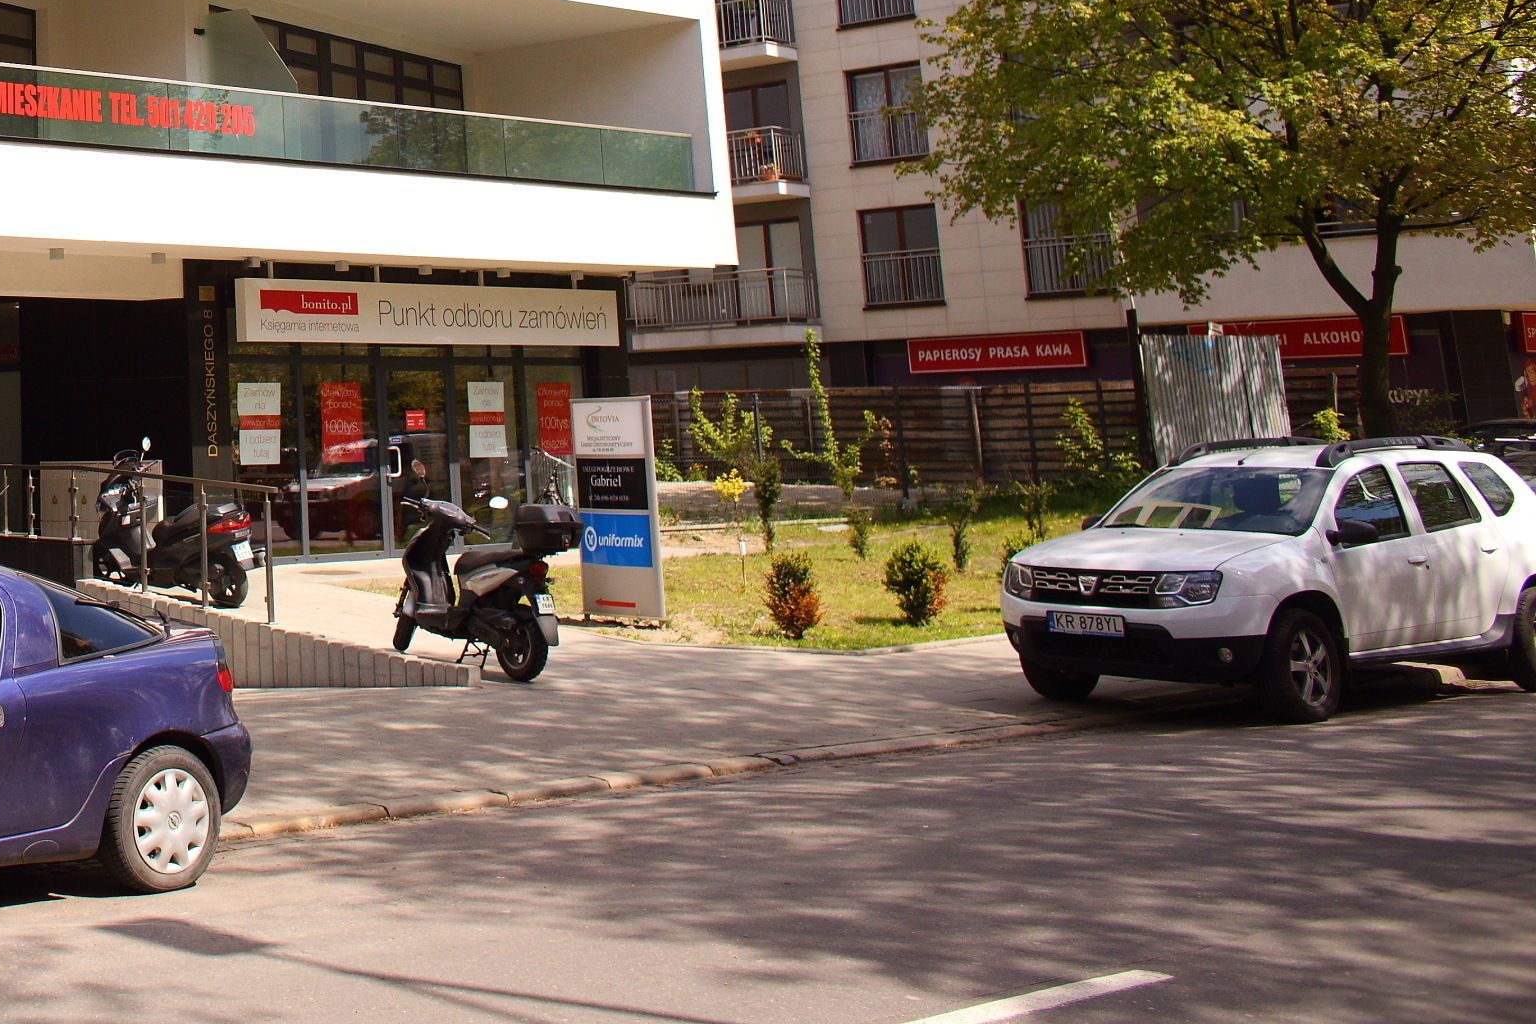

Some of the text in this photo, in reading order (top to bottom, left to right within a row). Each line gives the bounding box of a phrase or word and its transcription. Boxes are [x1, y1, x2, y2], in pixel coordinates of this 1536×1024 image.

[109, 92, 144, 127] TEL.
[146, 96, 180, 130] 501
[221, 104, 256, 137] 205
[301, 293, 352, 314] bonito.pl
[378, 300, 608, 331] Punkt odbioru zamówień
[260, 318, 360, 334] Księgarnia internetowa
[1303, 330, 1364, 345] ALKOHO
[918, 343, 1072, 362] PAPIEROSY PRASA KAWA
[203, 309, 218, 457] DASZYŃSKIEGO 8
[590, 474, 622, 488] Gabriel
[598, 533, 644, 548] uniformix
[1055, 613, 1075, 630] KR
[1079, 615, 1123, 633] 878YL
